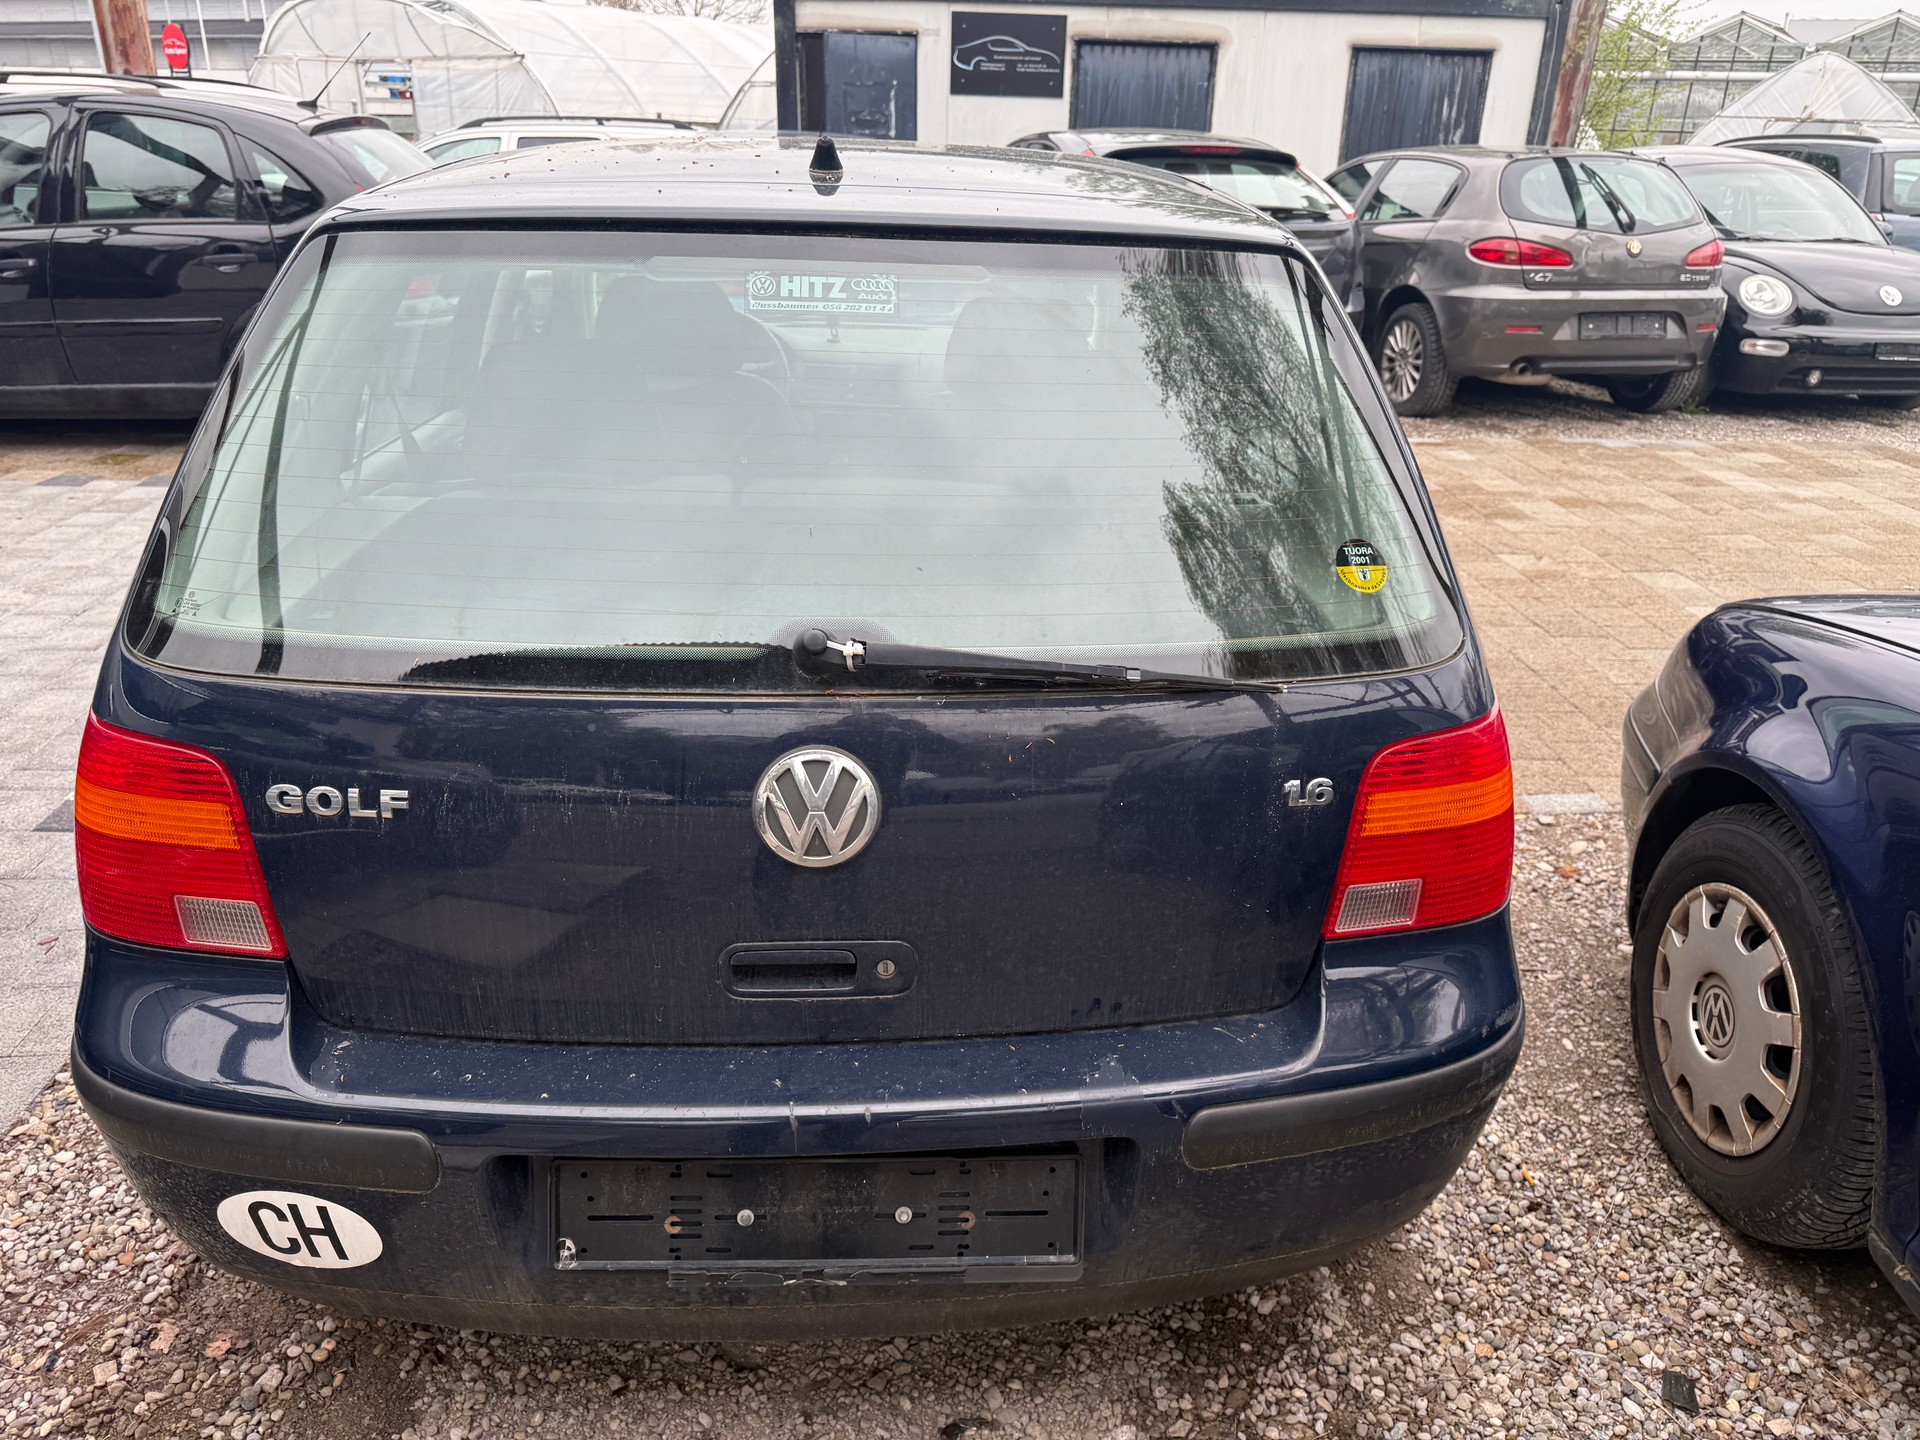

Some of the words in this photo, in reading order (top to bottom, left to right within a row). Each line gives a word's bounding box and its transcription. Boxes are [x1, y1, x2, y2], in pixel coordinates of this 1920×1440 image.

[780, 275, 848, 298] HITZ
[857, 292, 887, 300] Audi
[752, 301, 819, 310] Nussbaumen
[1343, 546, 1374, 555] TUORA
[1351, 556, 1370, 564] 2001
[1282, 777, 1335, 807] 1.6
[265, 783, 409, 819] GOLF
[247, 1200, 350, 1261] CH
